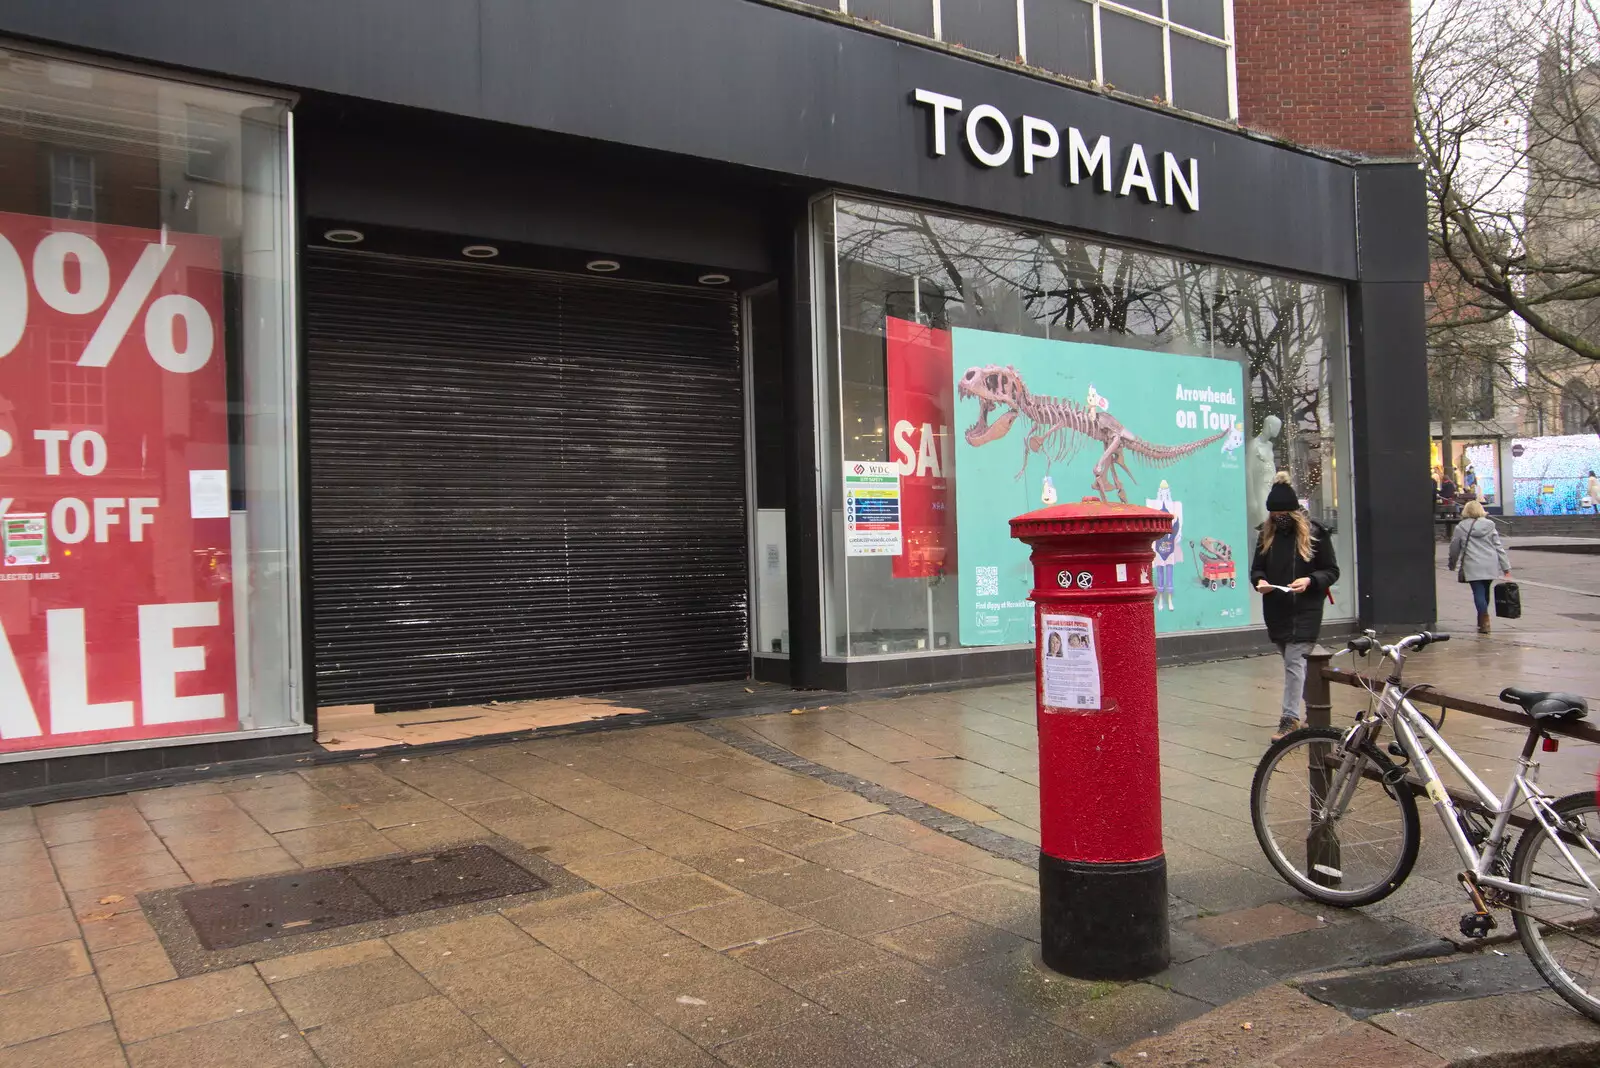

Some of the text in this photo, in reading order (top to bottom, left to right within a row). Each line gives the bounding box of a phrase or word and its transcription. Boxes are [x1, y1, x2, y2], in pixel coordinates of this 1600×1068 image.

[915, 88, 1199, 211] TOPMAN
[1176, 404, 1237, 430] on Tour
[33, 429, 108, 476] TO
[869, 466, 890, 474] WDC
[51, 497, 160, 544] OFF
[35, 572, 60, 580] LINES
